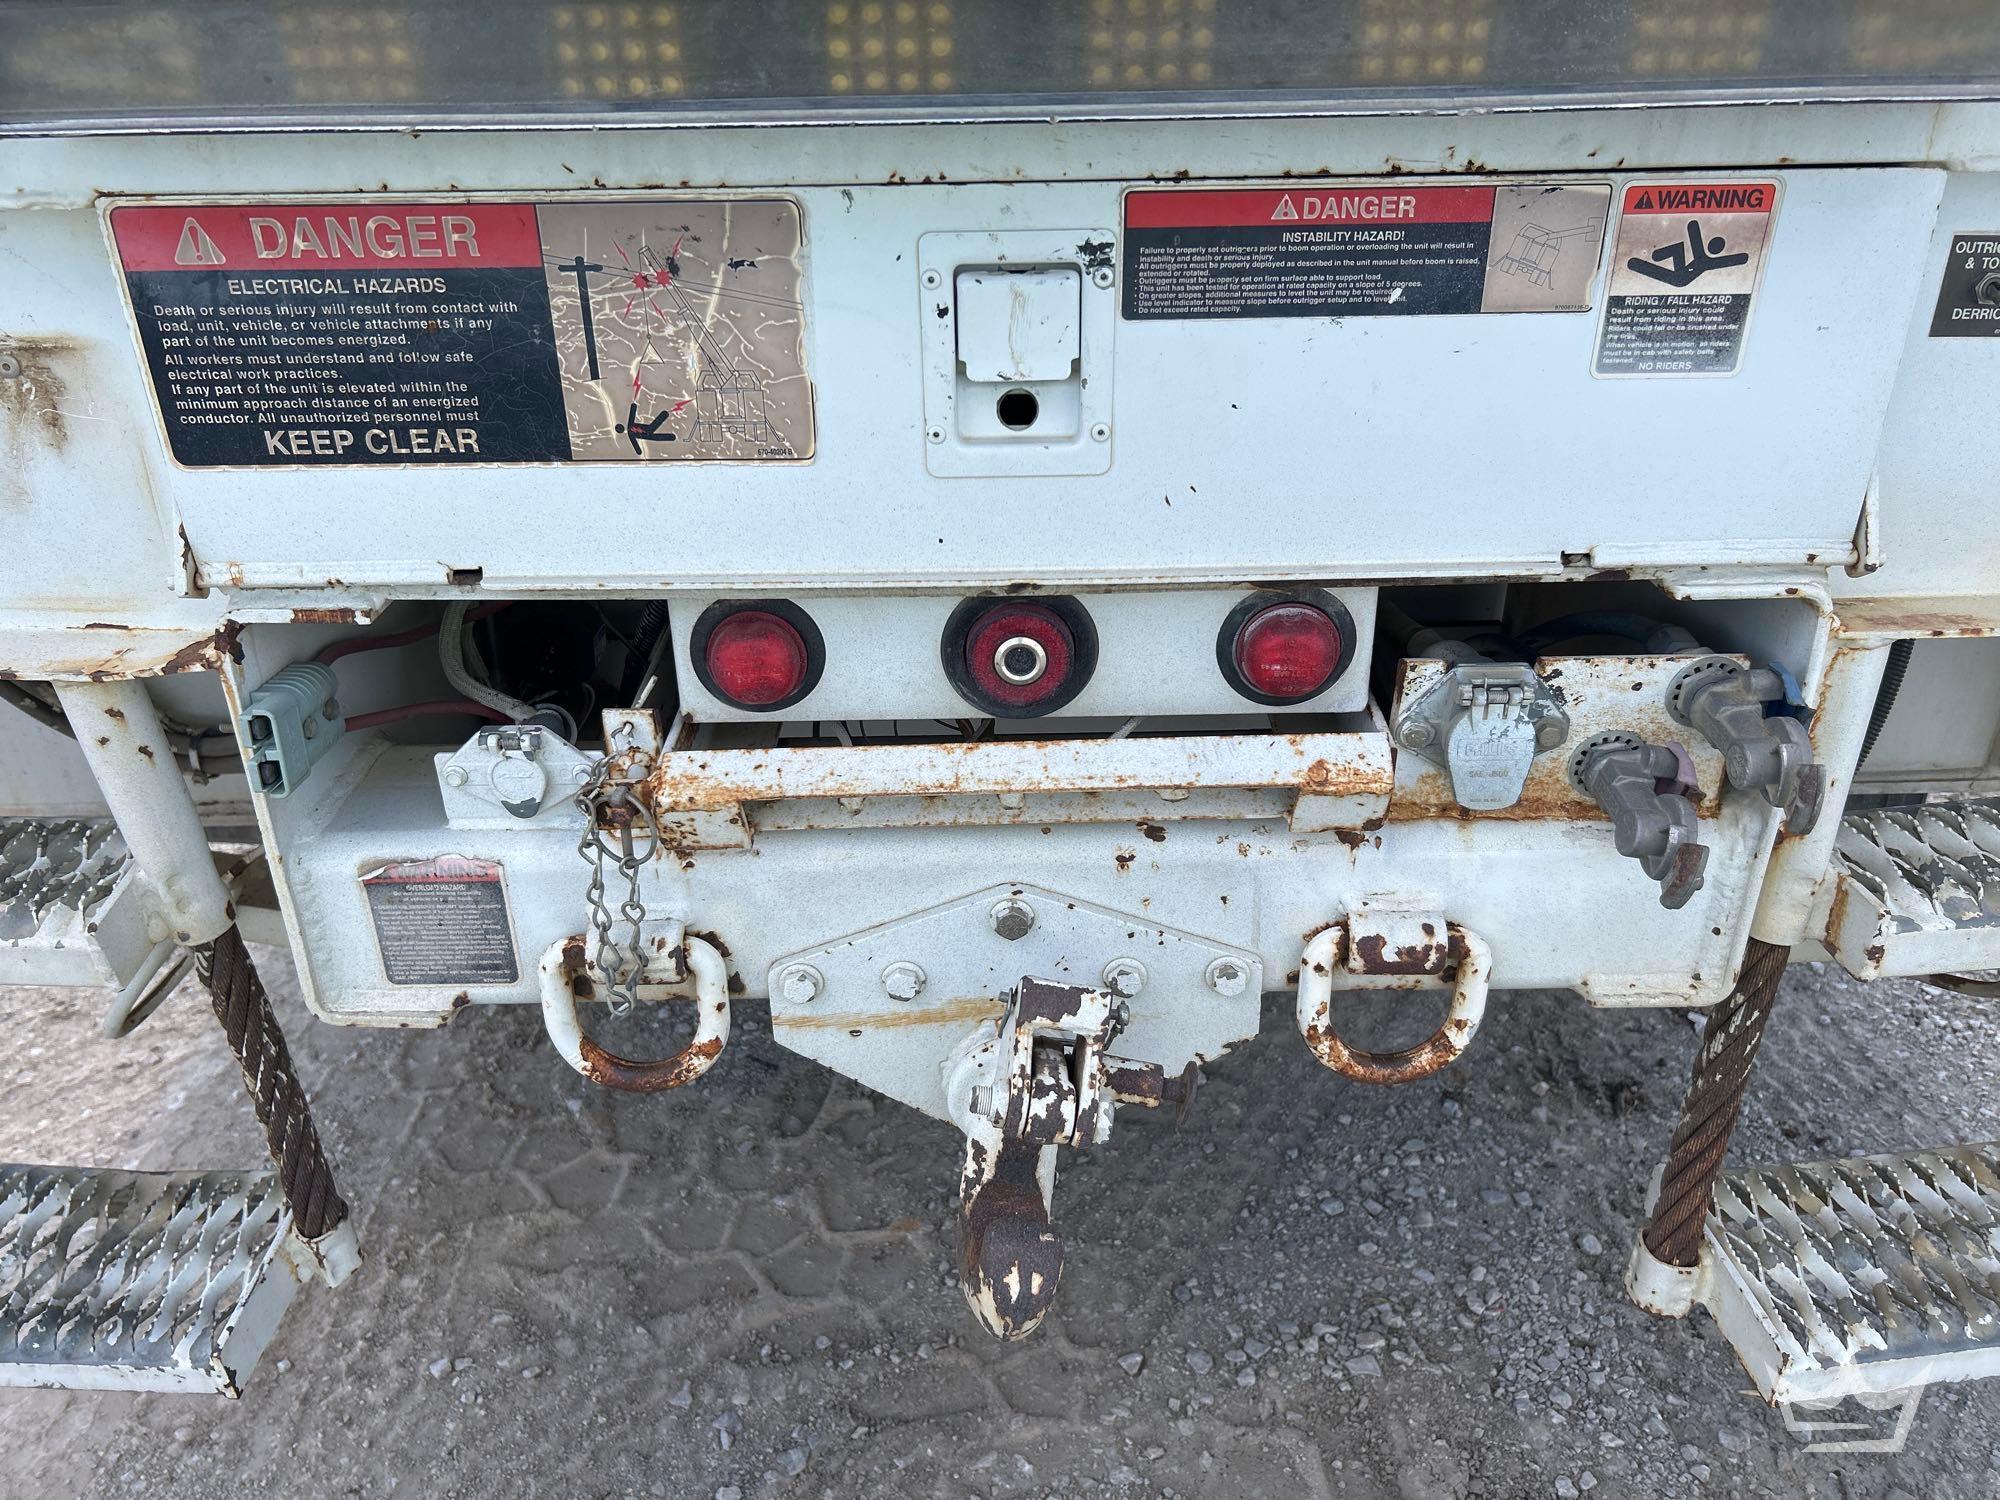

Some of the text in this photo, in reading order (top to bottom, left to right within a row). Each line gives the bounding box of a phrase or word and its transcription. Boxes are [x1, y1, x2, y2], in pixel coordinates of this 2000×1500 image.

[1657, 188, 1765, 209] WARNING
[1302, 196, 1416, 219] DANGER
[249, 215, 479, 259] DANGER
[1282, 230, 1405, 242] INSTABILITY HAZARD!
[1166, 246, 1174, 254] to
[1175, 246, 1206, 255] properly
[1220, 245, 1258, 255] outriggers
[1259, 245, 1277, 254] prior
[1287, 244, 1308, 252] boom
[1310, 244, 1345, 253] operation
[1355, 243, 1399, 252] overloading
[1413, 242, 1428, 250] unit
[1150, 262, 1187, 271] outriggers
[1189, 261, 1207, 269] must
[1219, 261, 1250, 270] properly
[1251, 260, 1285, 270] deployed
[1455, 257, 1480, 265] raised.
[1964, 257, 1975, 269] &
[227, 277, 446, 295] ELECTRICAL HAZARDS
[1241, 282, 1275, 291] operation
[1305, 281, 1336, 291] capacity
[1355, 281, 1375, 290] slope
[1391, 280, 1422, 289] degrees.
[1624, 296, 1732, 306] RIDING / FALL HAZARD
[153, 301, 517, 319] Death or serious injury will result from contact with
[1677, 306, 1700, 315] injury
[157, 316, 493, 335] load, unit, vehicle, or vehicle attachments if any
[1652, 315, 1677, 324] riding
[161, 332, 410, 351] part of the unit becomes energized.
[163, 353, 183, 364] All
[186, 352, 243, 364] workers
[246, 352, 281, 364] must
[285, 351, 364, 363] understand
[368, 351, 394, 363] and
[444, 350, 473, 362] safe
[1638, 361, 1692, 370] NO RIDERS
[166, 366, 342, 382] electrical work practices.
[171, 381, 467, 398] If any part of the unit is elevated within the
[175, 395, 479, 412] minimum approach distance of an energized
[179, 409, 479, 426] conductor. All unauthorized personnel must
[263, 428, 479, 455] KEEP CLEAR
